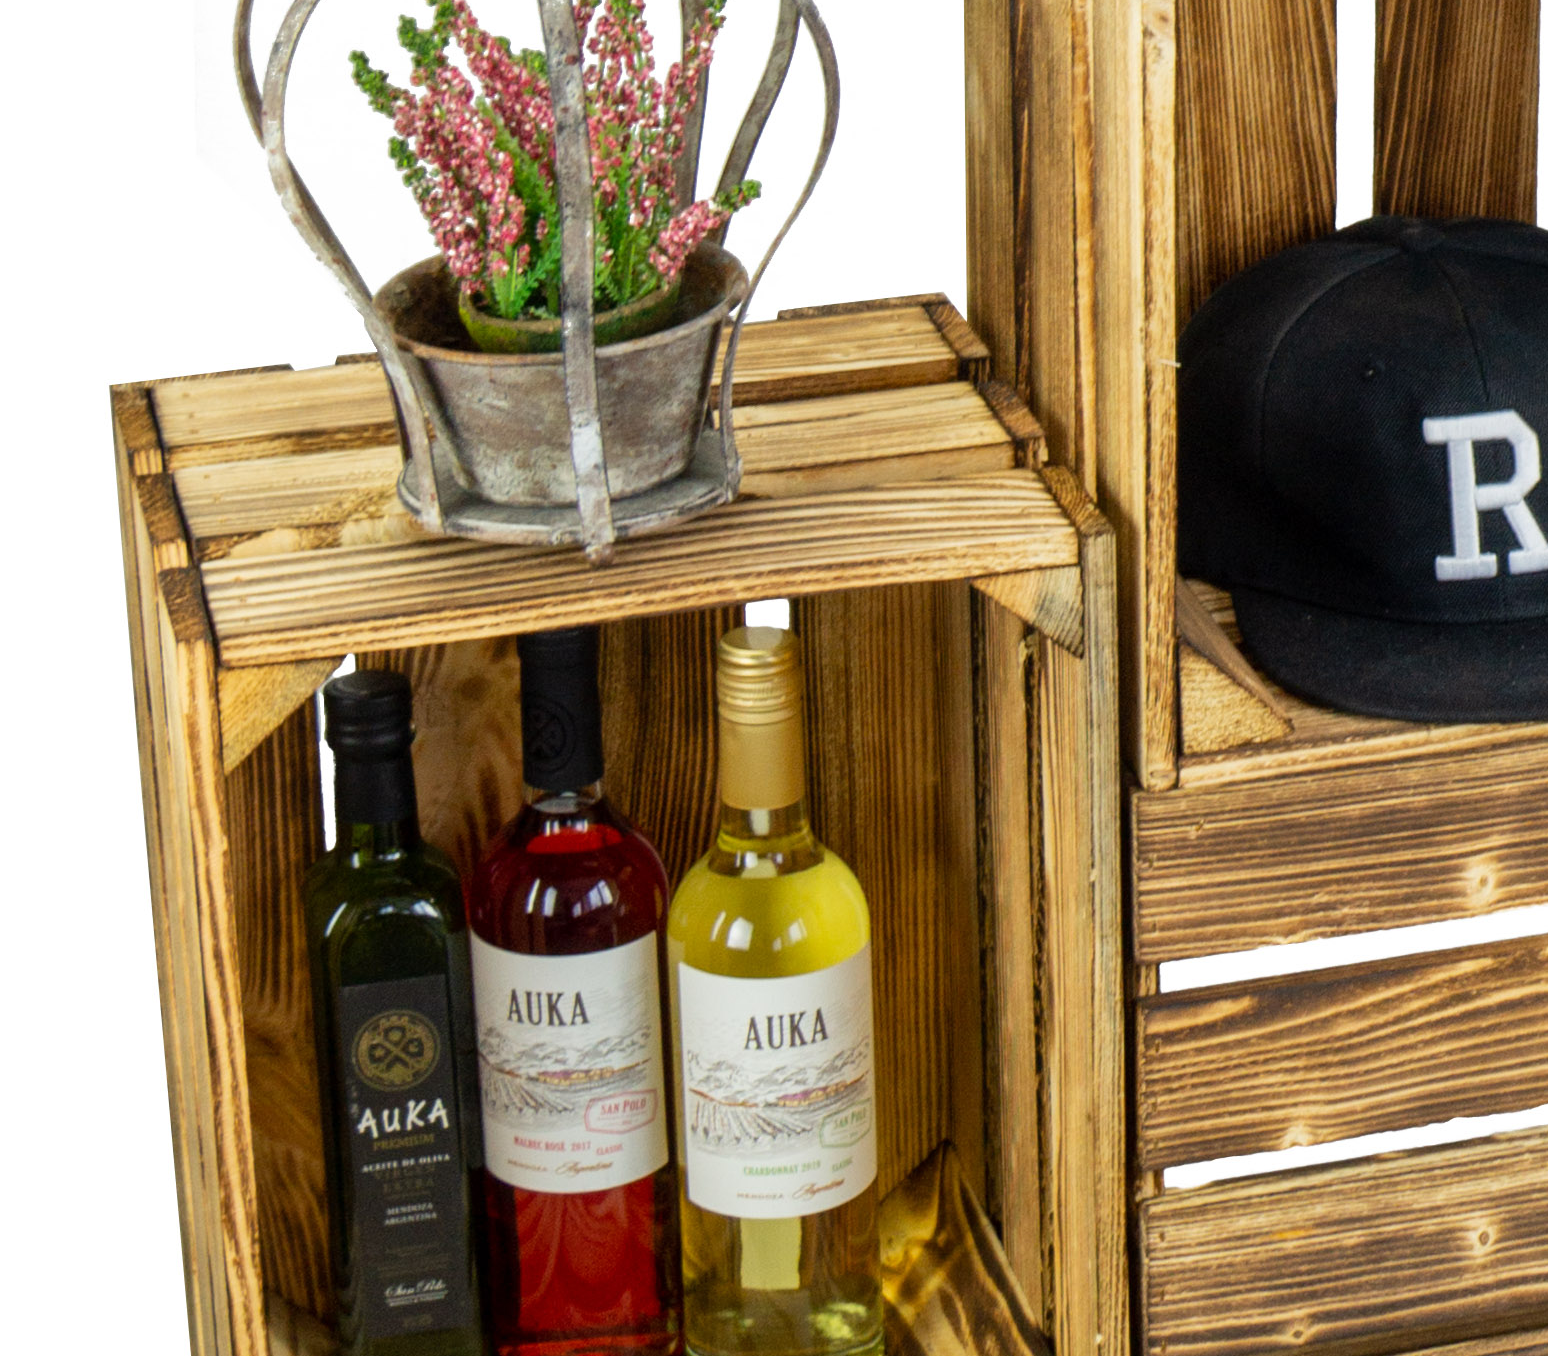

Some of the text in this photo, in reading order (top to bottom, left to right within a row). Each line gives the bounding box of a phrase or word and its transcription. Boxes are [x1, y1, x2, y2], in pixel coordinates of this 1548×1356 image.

[507, 988, 590, 1027] AUKA
[744, 1007, 829, 1051] AUKA
[357, 1097, 449, 1139] AUKA
[361, 1153, 451, 1174] ACEITE DE OLIVA
